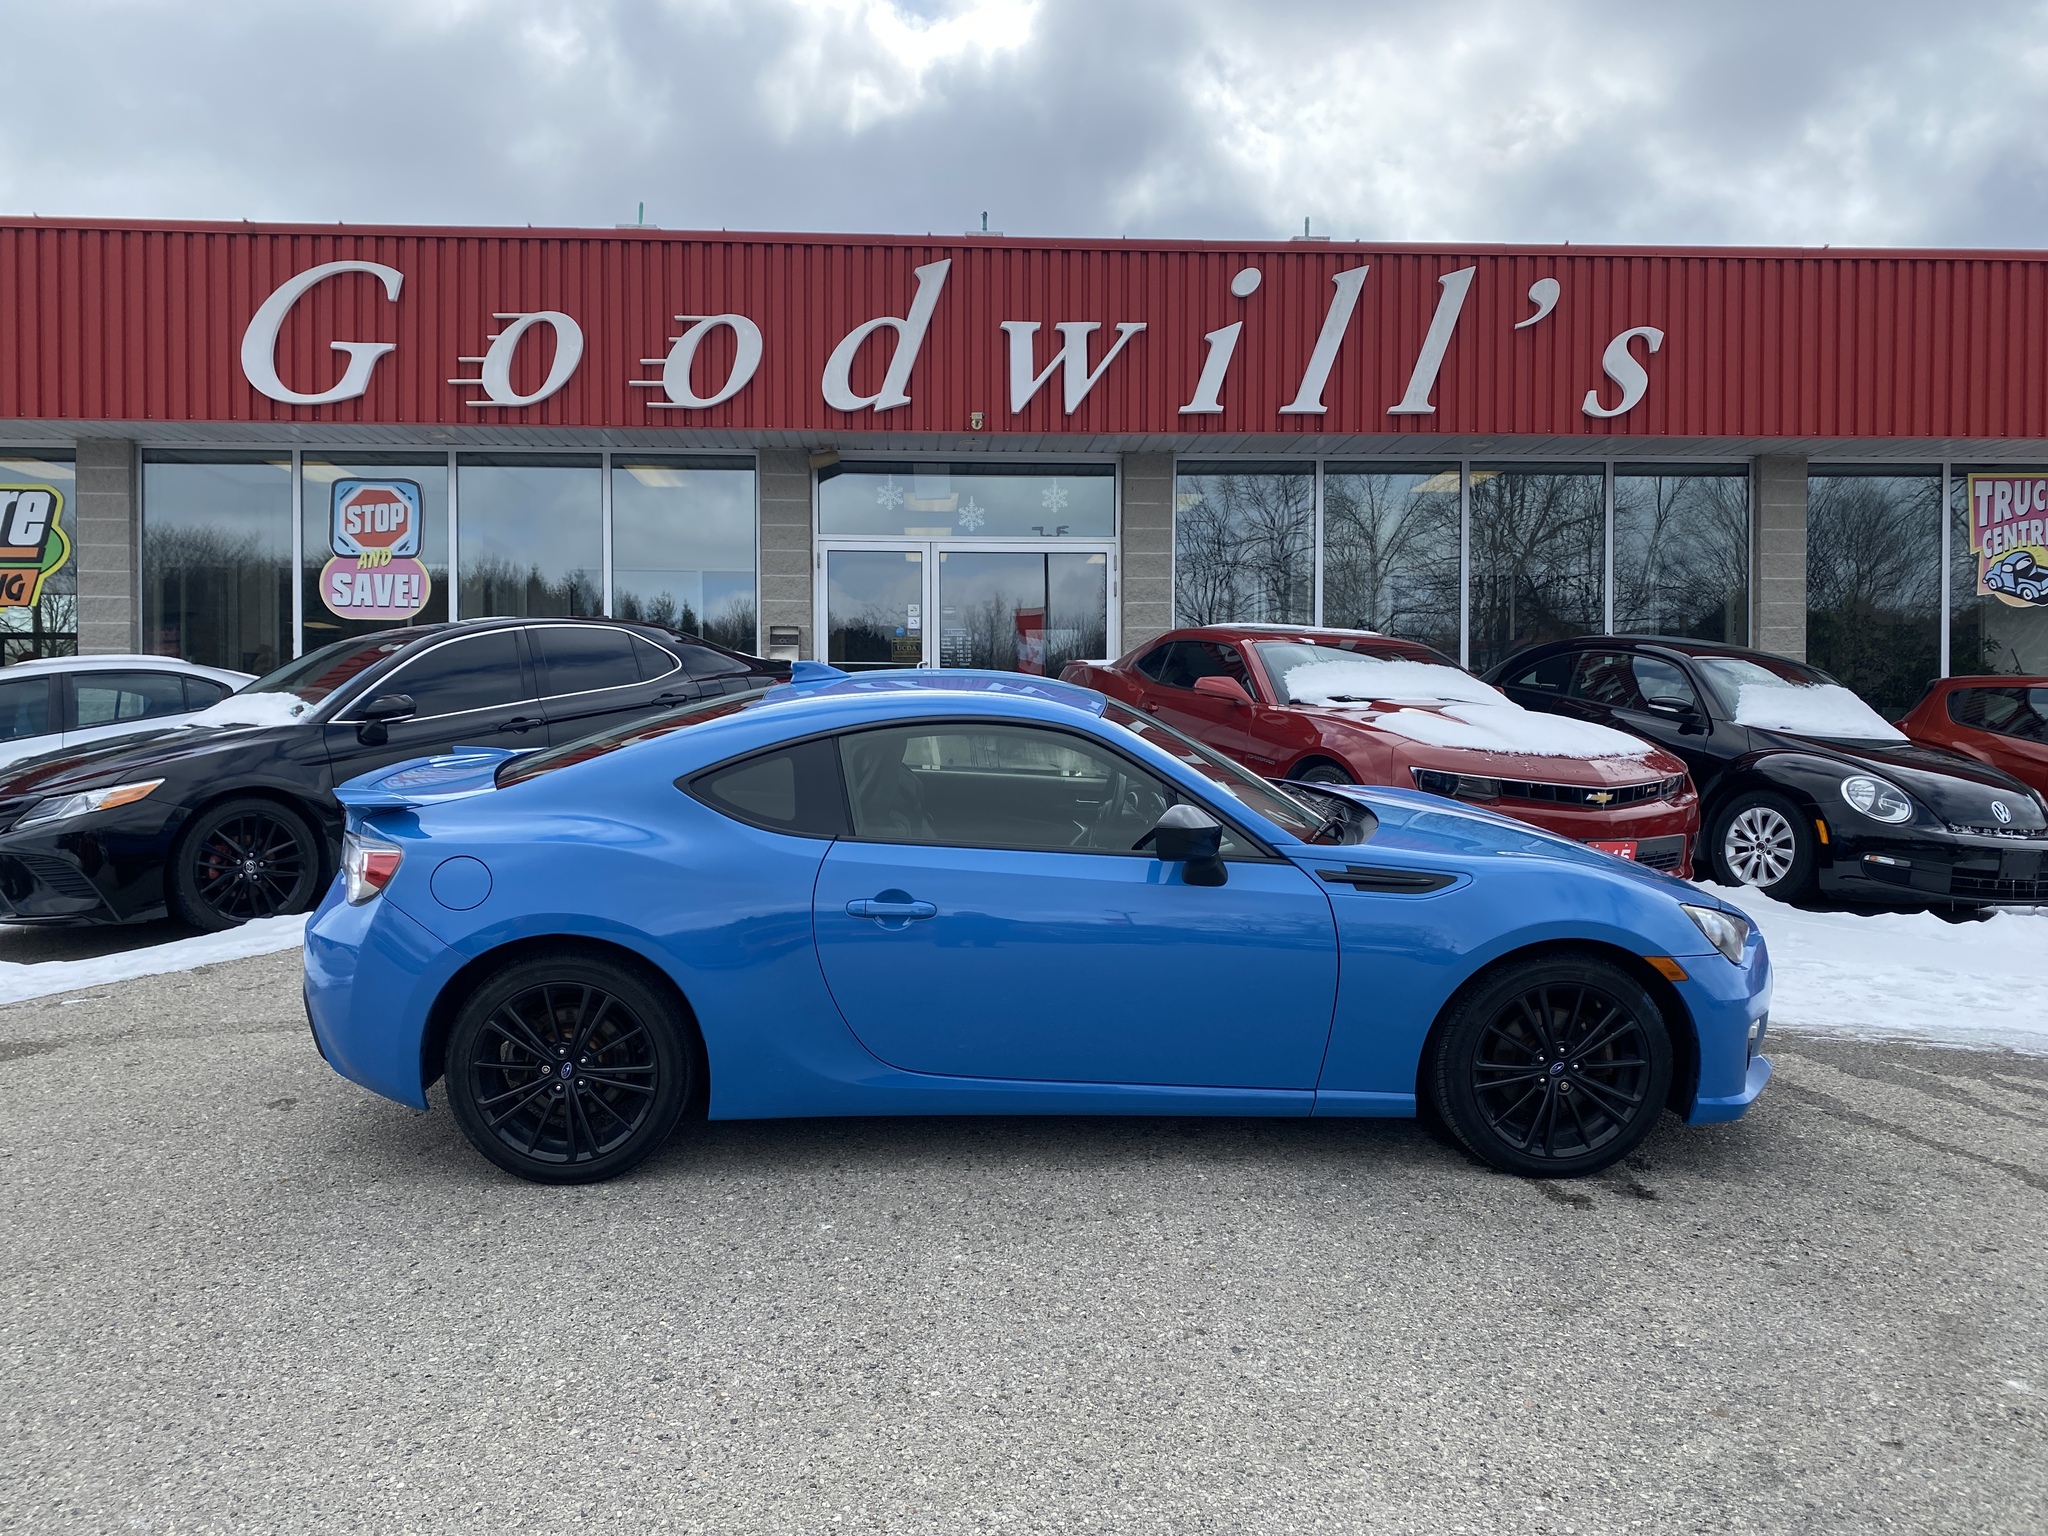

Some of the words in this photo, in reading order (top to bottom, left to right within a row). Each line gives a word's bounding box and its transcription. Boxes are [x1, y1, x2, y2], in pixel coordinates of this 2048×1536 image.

[240, 257, 1665, 420] Goodwill's
[346, 503, 405, 535] STOP
[1975, 480, 2048, 528] TRUC
[356, 548, 393, 570] AND
[331, 572, 420, 609] SAVE!
